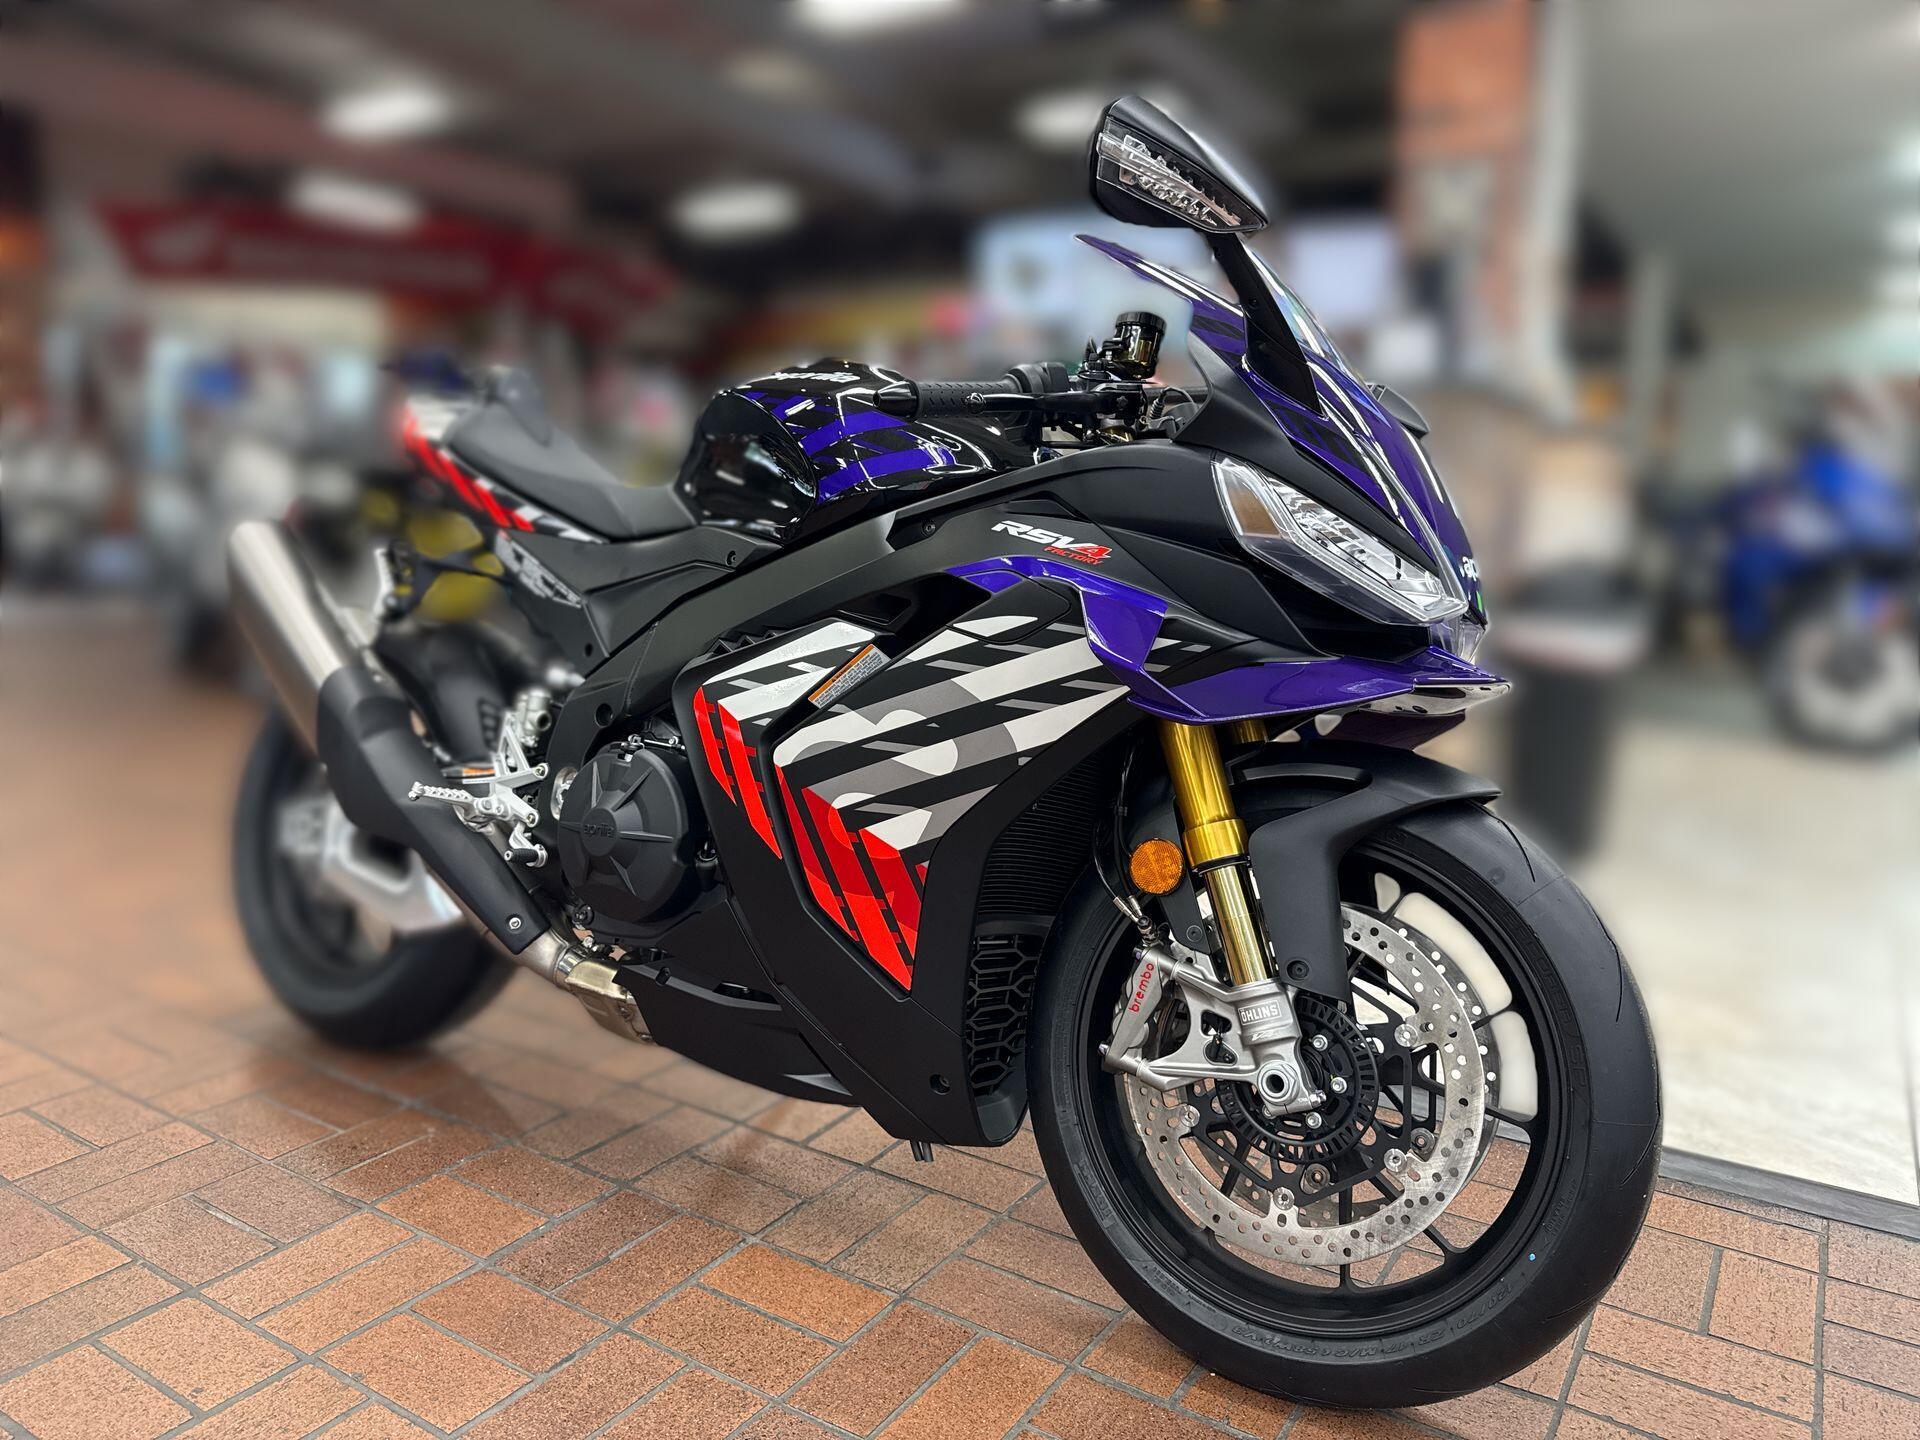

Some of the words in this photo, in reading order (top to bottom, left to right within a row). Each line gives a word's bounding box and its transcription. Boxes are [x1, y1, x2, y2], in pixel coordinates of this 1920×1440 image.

[991, 520, 1112, 559] RSV4
[1043, 546, 1103, 565] FACTORY
[1128, 962, 1155, 1015] brembo
[1240, 1003, 1279, 1022] ÖHLINS
